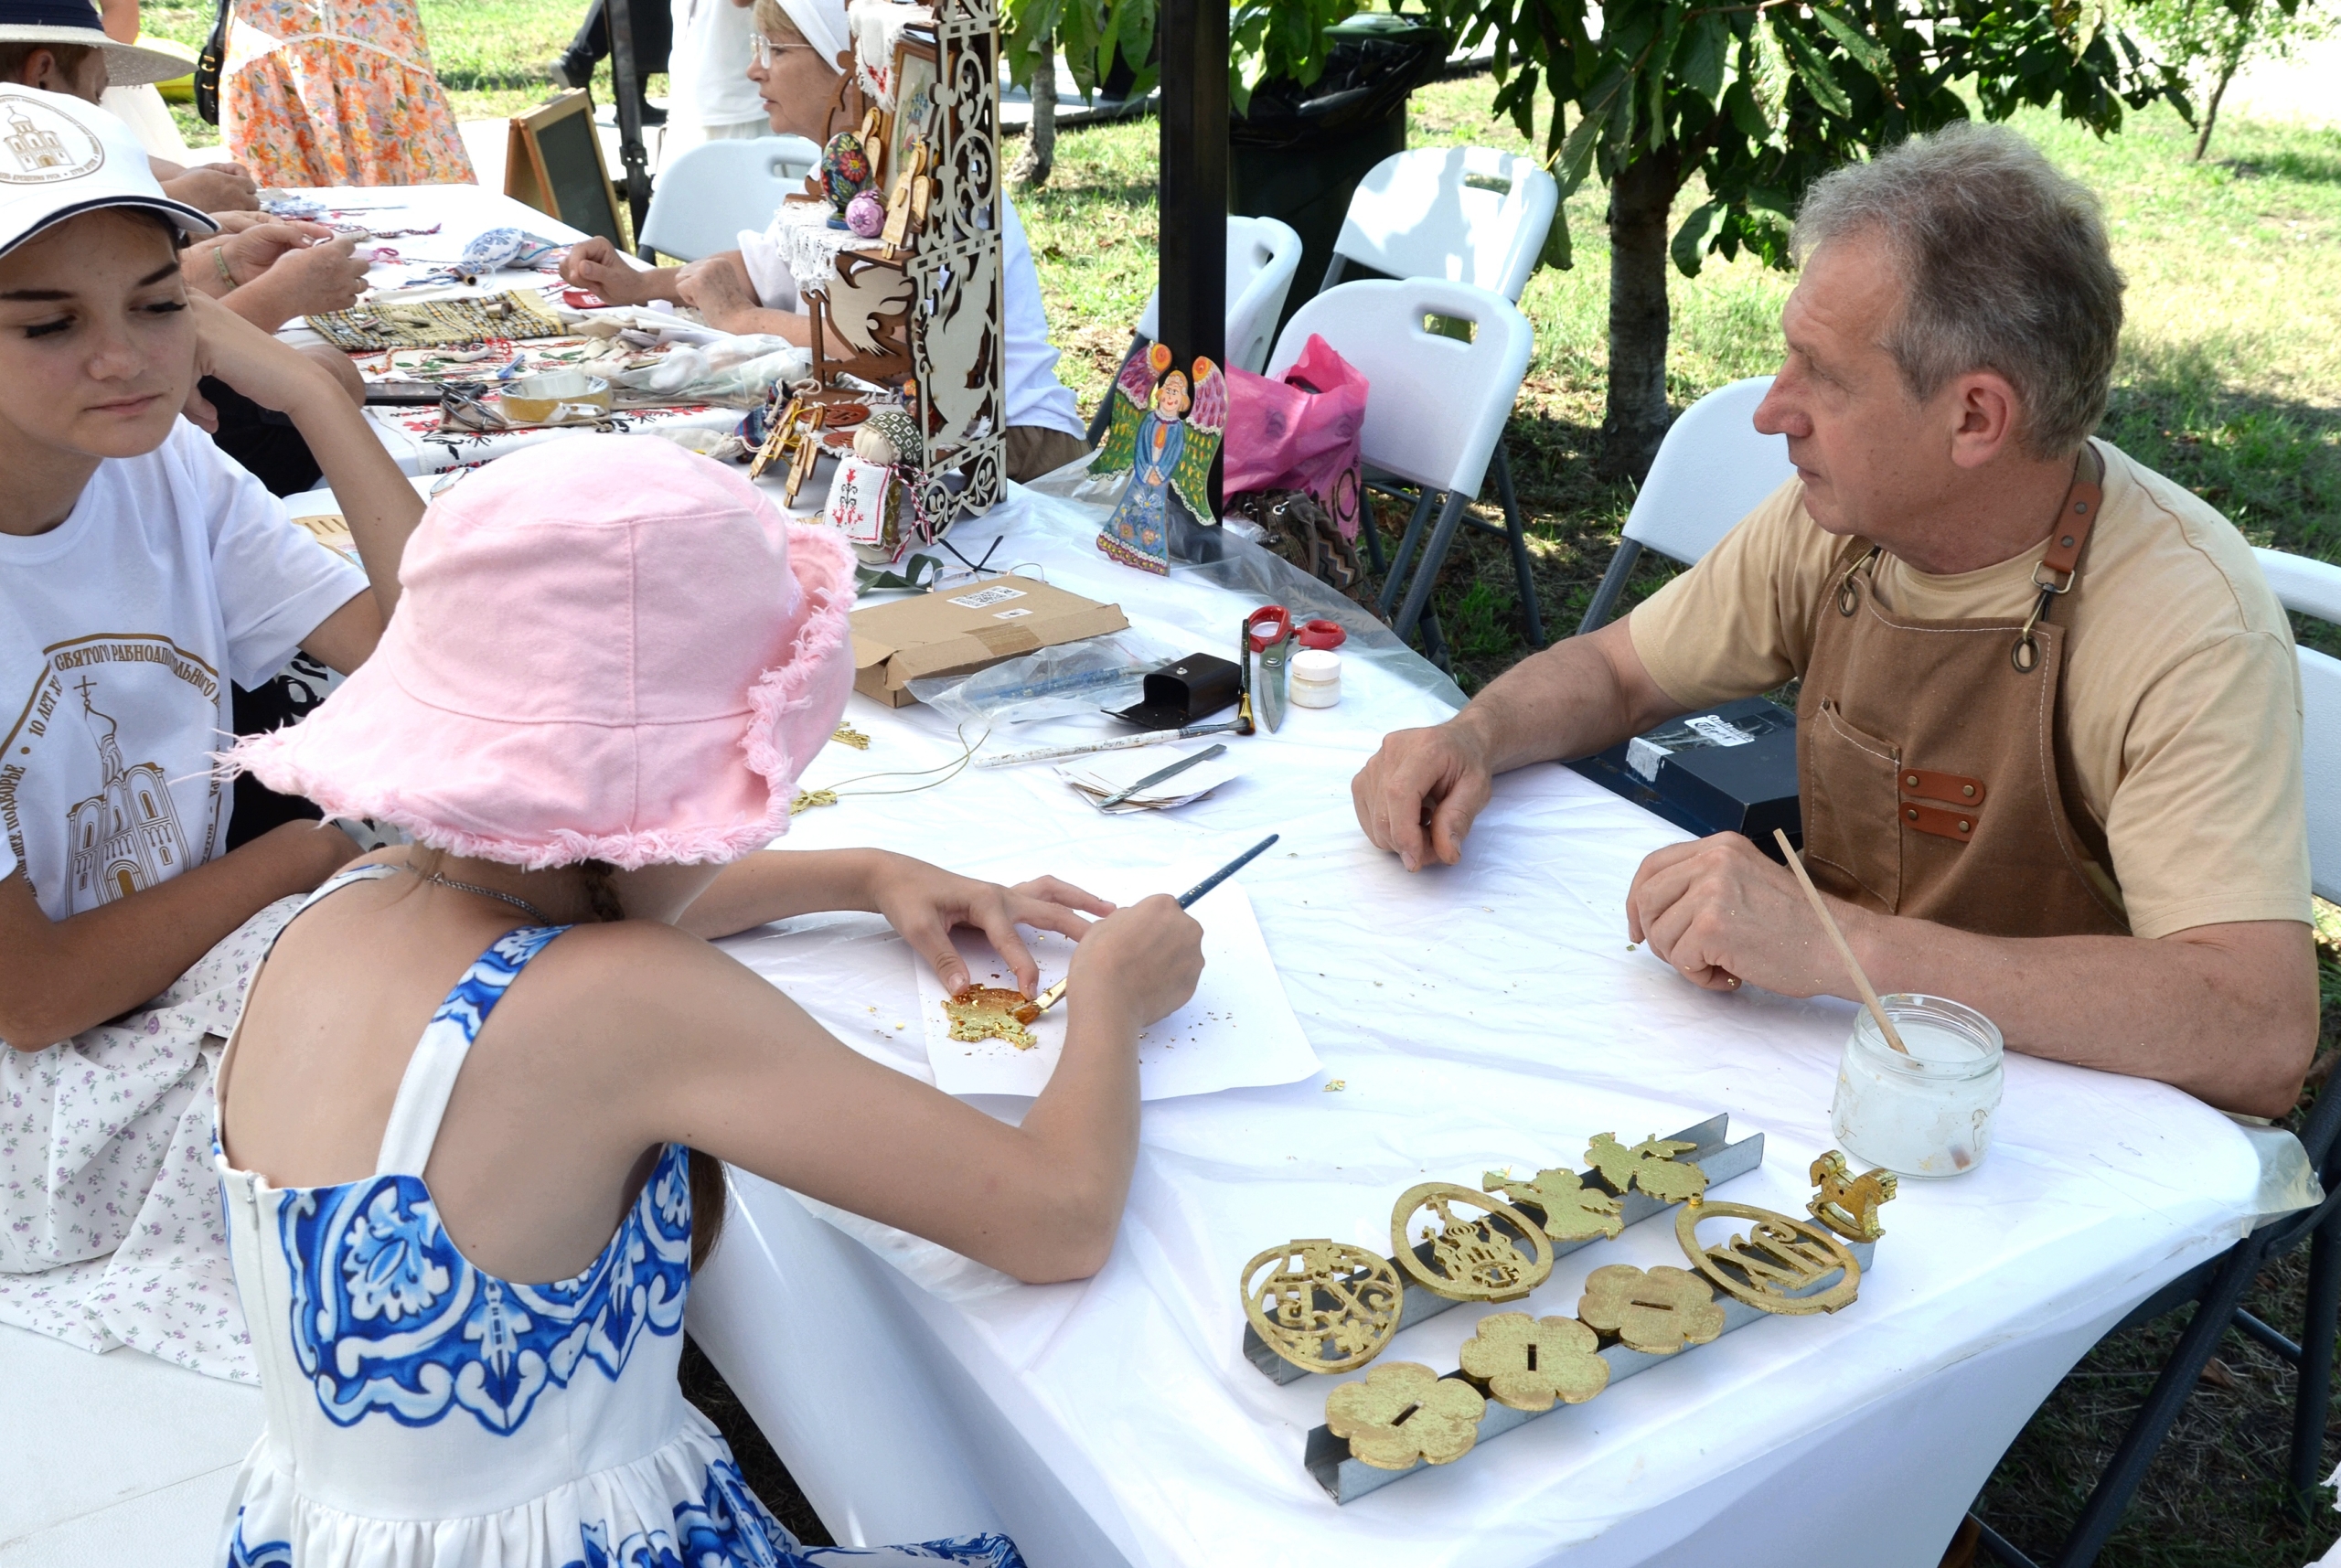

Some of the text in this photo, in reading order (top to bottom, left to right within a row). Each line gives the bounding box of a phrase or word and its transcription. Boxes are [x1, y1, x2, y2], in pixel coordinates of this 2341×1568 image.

[55, 645, 110, 672] СВЯТОГО
[37, 689, 58, 723] ЛЕТ
[28, 720, 47, 738] 10
